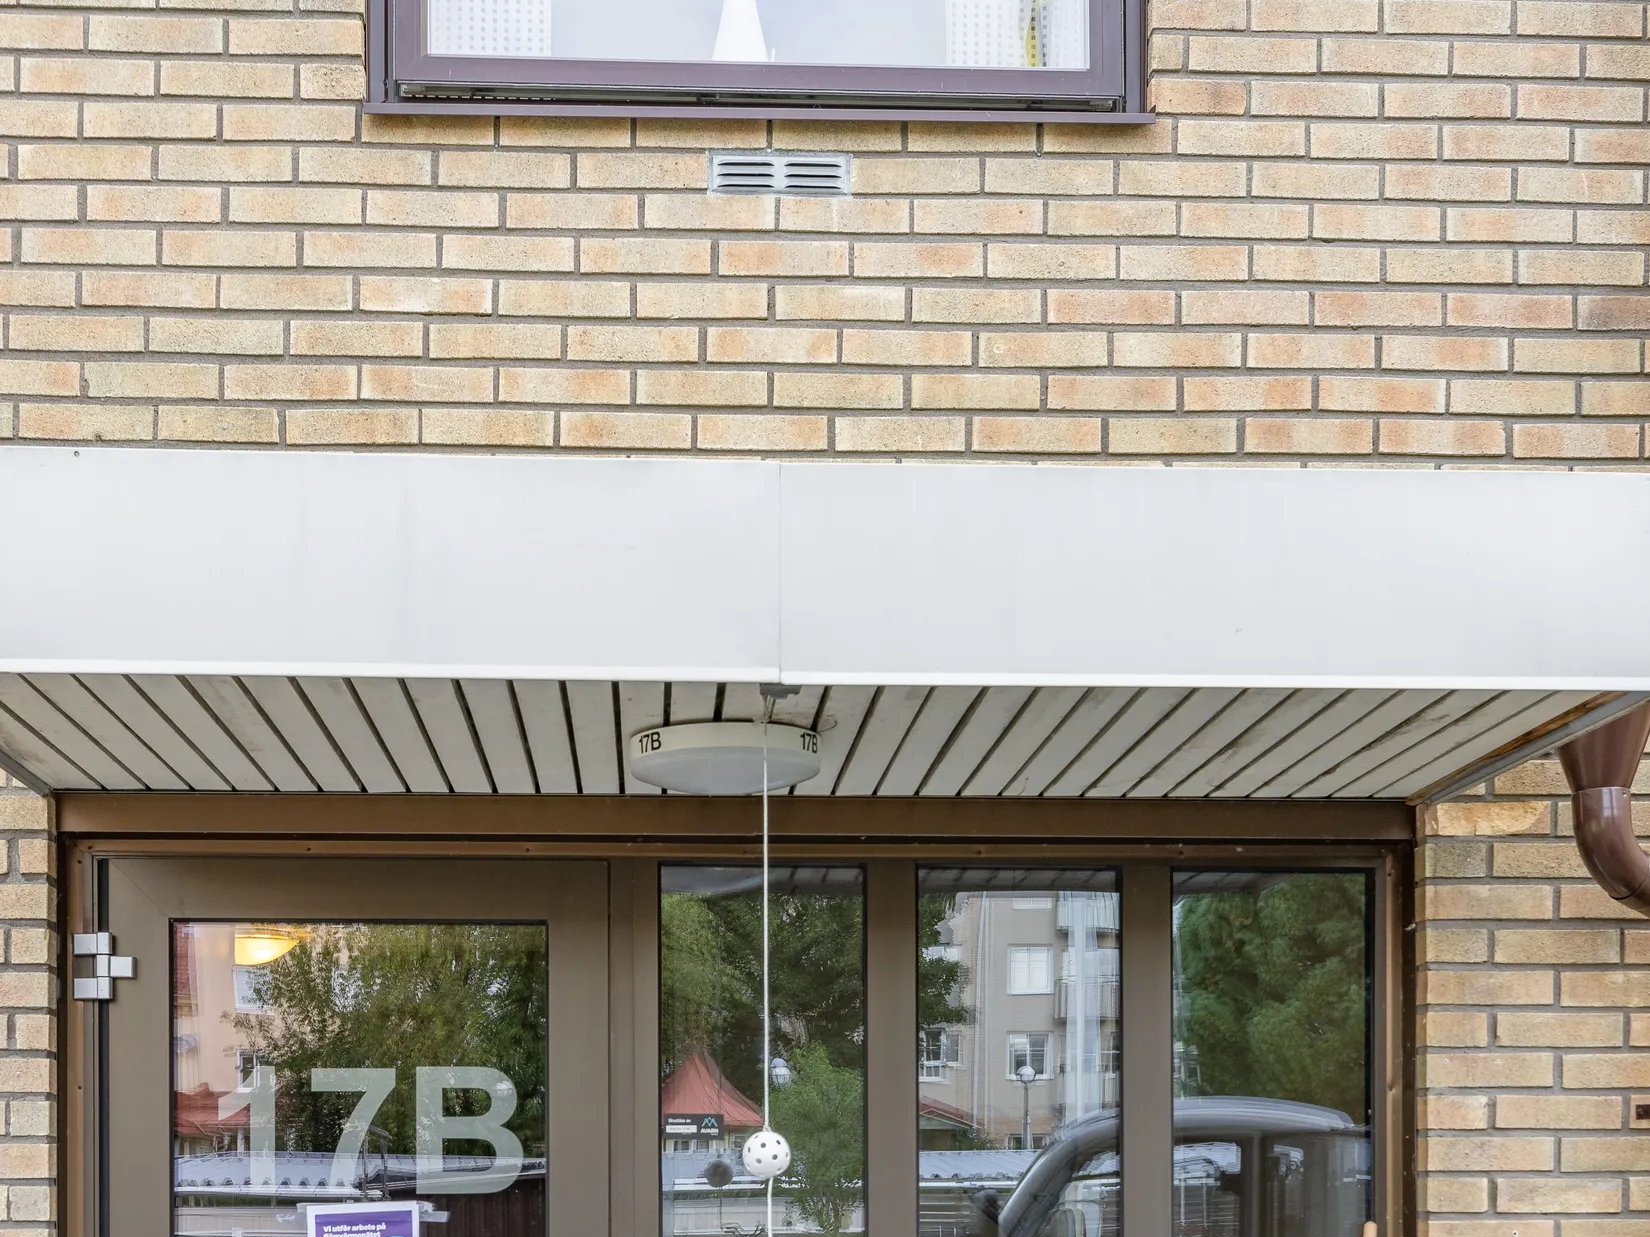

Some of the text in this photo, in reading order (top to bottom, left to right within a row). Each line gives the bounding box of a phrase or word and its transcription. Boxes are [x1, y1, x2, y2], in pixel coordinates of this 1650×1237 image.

[638, 731, 662, 754] 17B
[800, 731, 819, 754] 17B
[217, 1065, 524, 1195] 17B
[333, 1224, 351, 1232] utför
[376, 1222, 386, 1231] på
